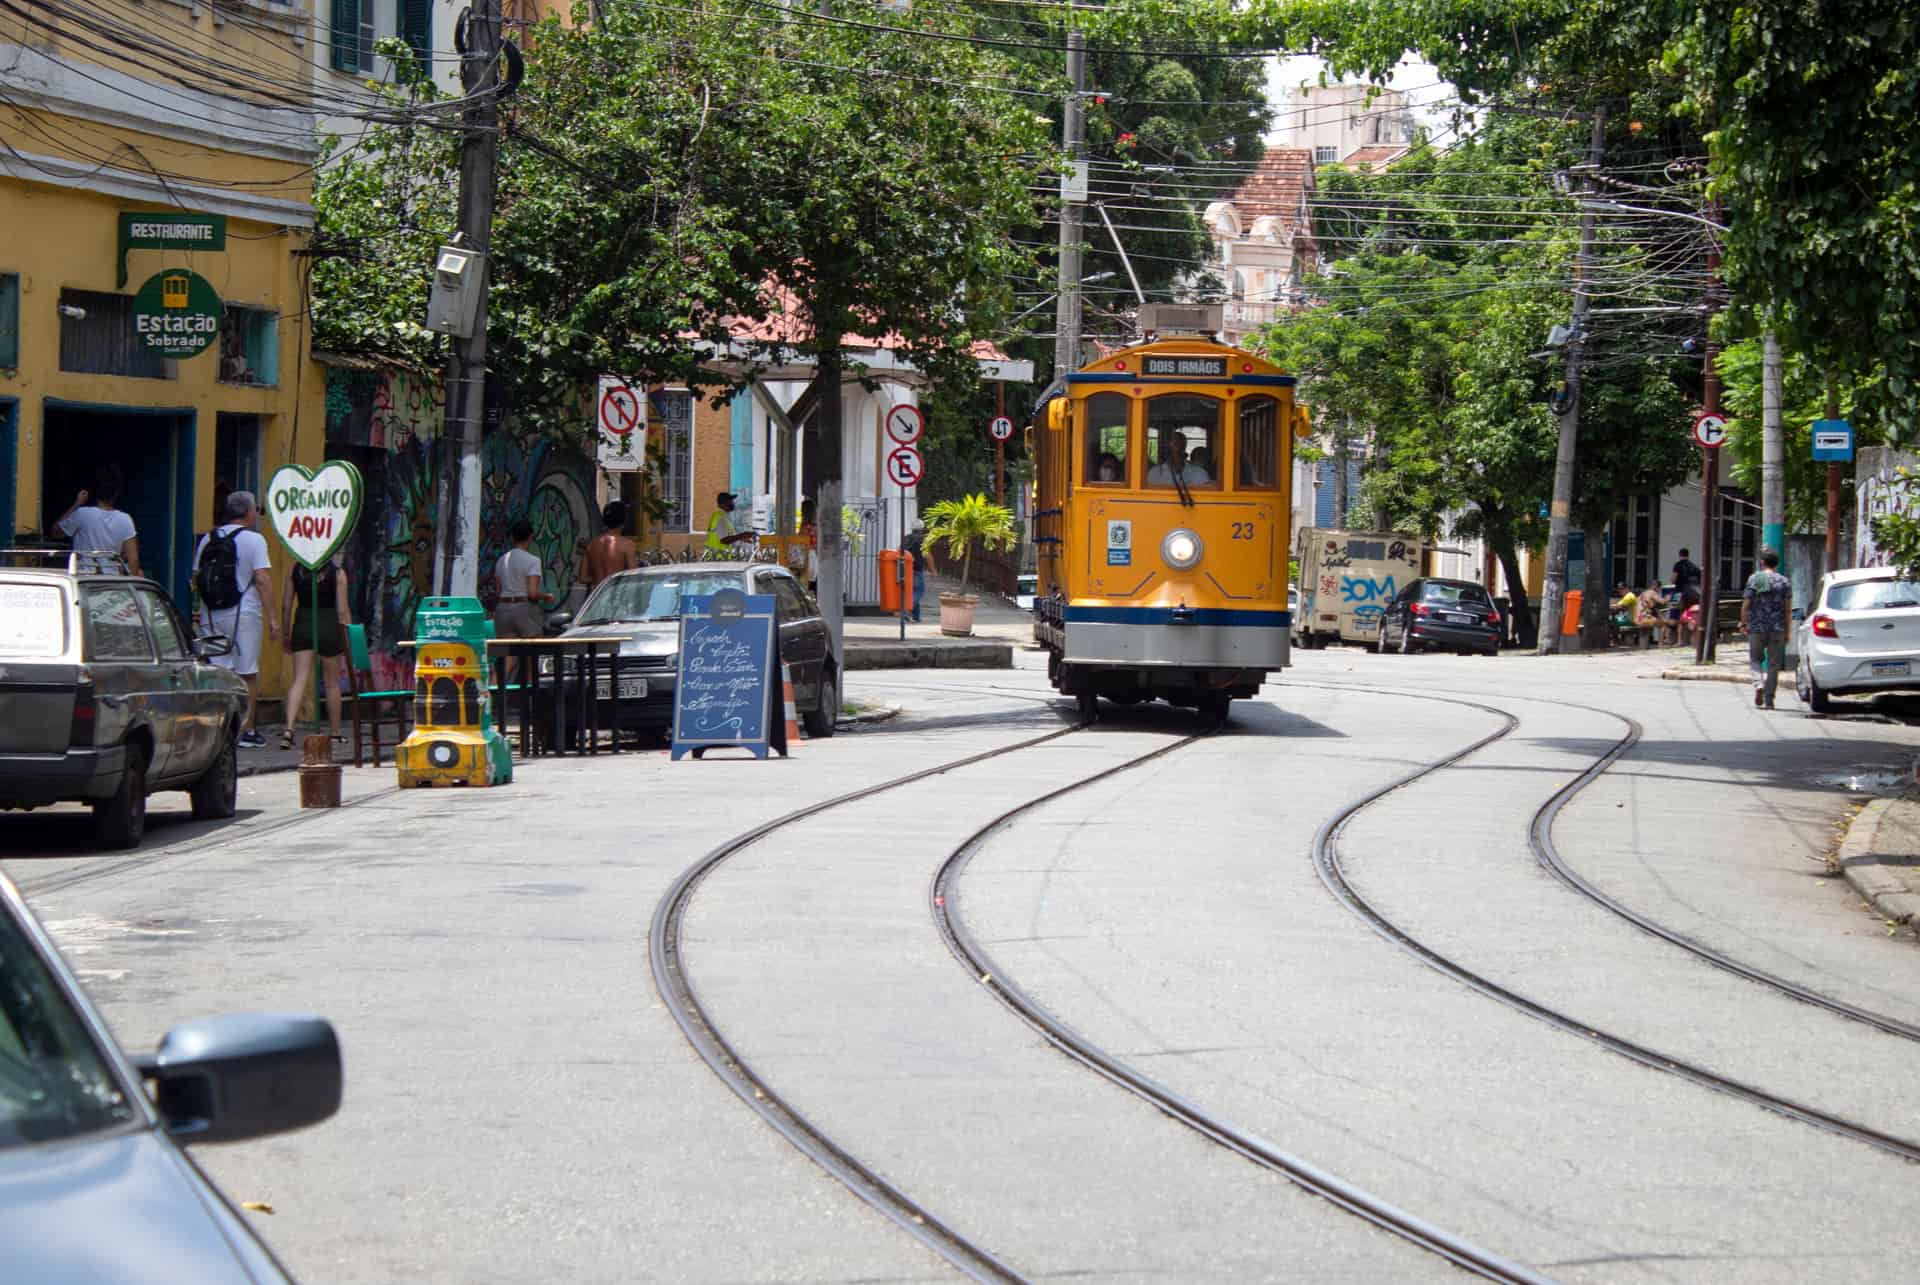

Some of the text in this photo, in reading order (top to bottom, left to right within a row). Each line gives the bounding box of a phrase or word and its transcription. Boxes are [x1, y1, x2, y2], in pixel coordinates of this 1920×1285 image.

[131, 223, 214, 240] RESTAURANTE
[137, 313, 217, 334] Estação
[146, 334, 206, 347] Sobrado
[1149, 360, 1176, 374] DOIS
[1231, 521, 1255, 541] 23
